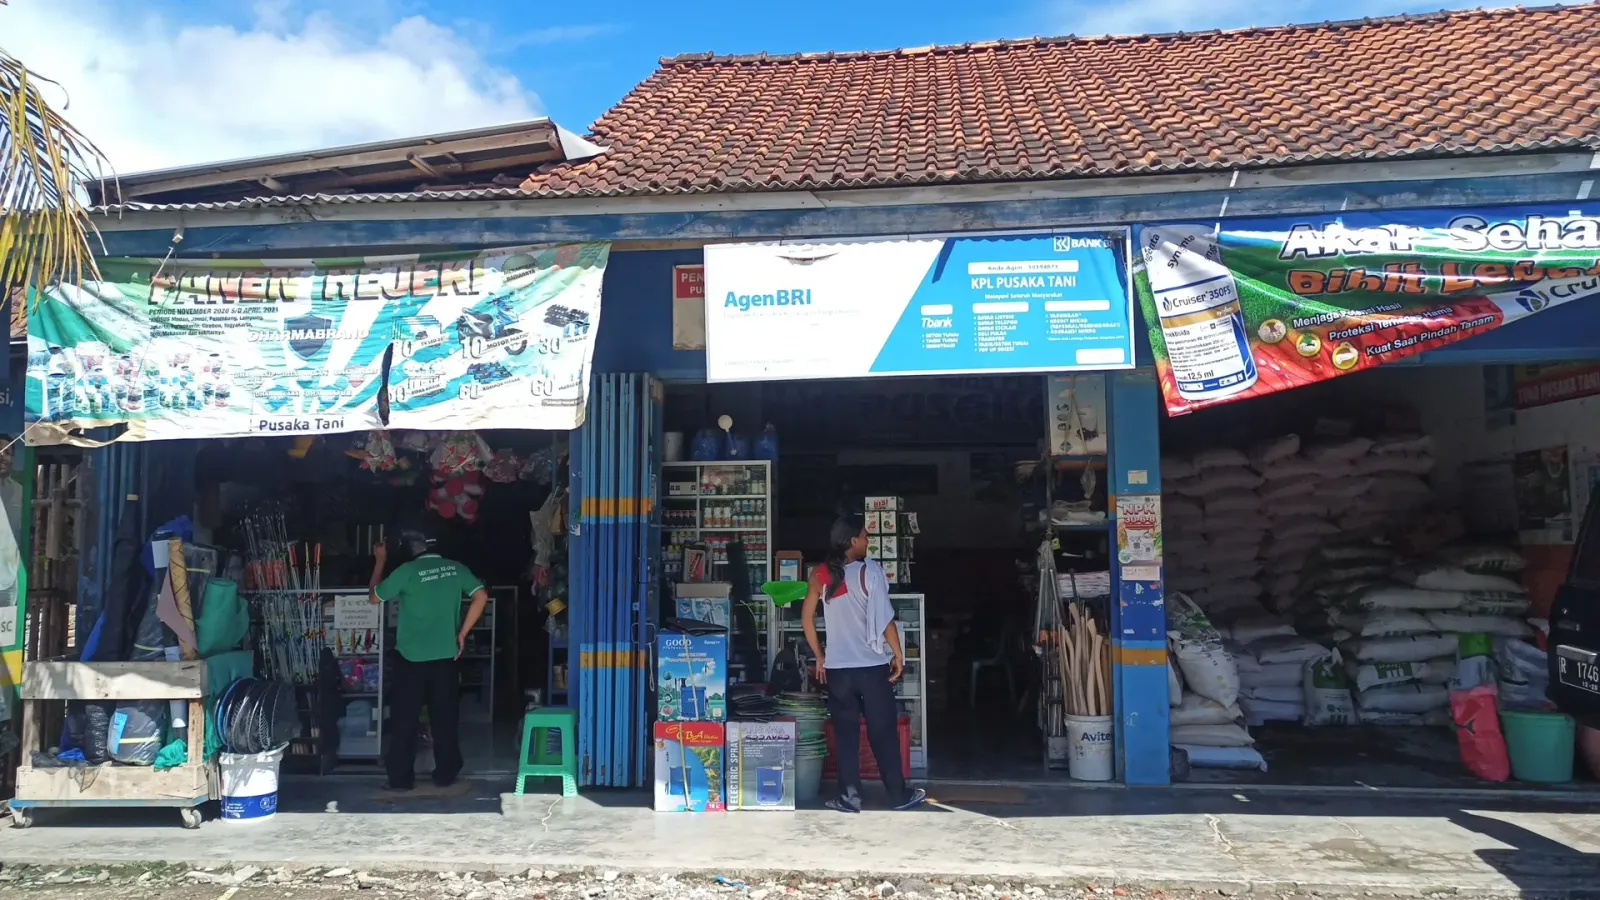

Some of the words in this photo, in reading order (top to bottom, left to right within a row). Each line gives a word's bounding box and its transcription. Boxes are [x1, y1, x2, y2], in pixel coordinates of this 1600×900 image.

[1071, 239, 1101, 248] BANK
[1278, 223, 1416, 260] Akar
[1167, 234, 1196, 269] syngenta
[148, 267, 296, 306] PANEN
[321, 261, 482, 302] REJEKI
[971, 277, 994, 289] KPL
[997, 275, 1046, 288] PUSAKA
[1047, 275, 1076, 287] TANI
[1287, 263, 1427, 296] Bibit
[724, 288, 812, 312] AgenBRI
[985, 292, 1009, 300] Melayani
[1032, 291, 1063, 300] Masyarakat
[1209, 285, 1232, 301] 350FS
[177, 308, 212, 316] NOVEMBER
[243, 307, 261, 315] APRIL
[1293, 311, 1338, 328] Menjaga
[1377, 302, 1403, 313] Hasil
[1329, 323, 1375, 341] Proteksi
[1423, 306, 1453, 320] Hama
[248, 328, 370, 342] DHARMABRAND
[1366, 342, 1393, 356] Kuat
[1393, 336, 1419, 350] Saat
[1419, 326, 1459, 344] Pindah
[1460, 314, 1495, 330] Tanam
[486, 337, 511, 350] MOTOR
[1187, 371, 1203, 382] 12,5
[1204, 369, 1215, 379] ml
[259, 419, 310, 431] Pusaka
[314, 416, 345, 430] Tani
[873, 499, 889, 509] BISI
[1123, 503, 1156, 516] NPK
[665, 639, 692, 647] GOOD
[1577, 661, 1599, 683] 1746
[729, 766, 739, 804] ELECTRIC
